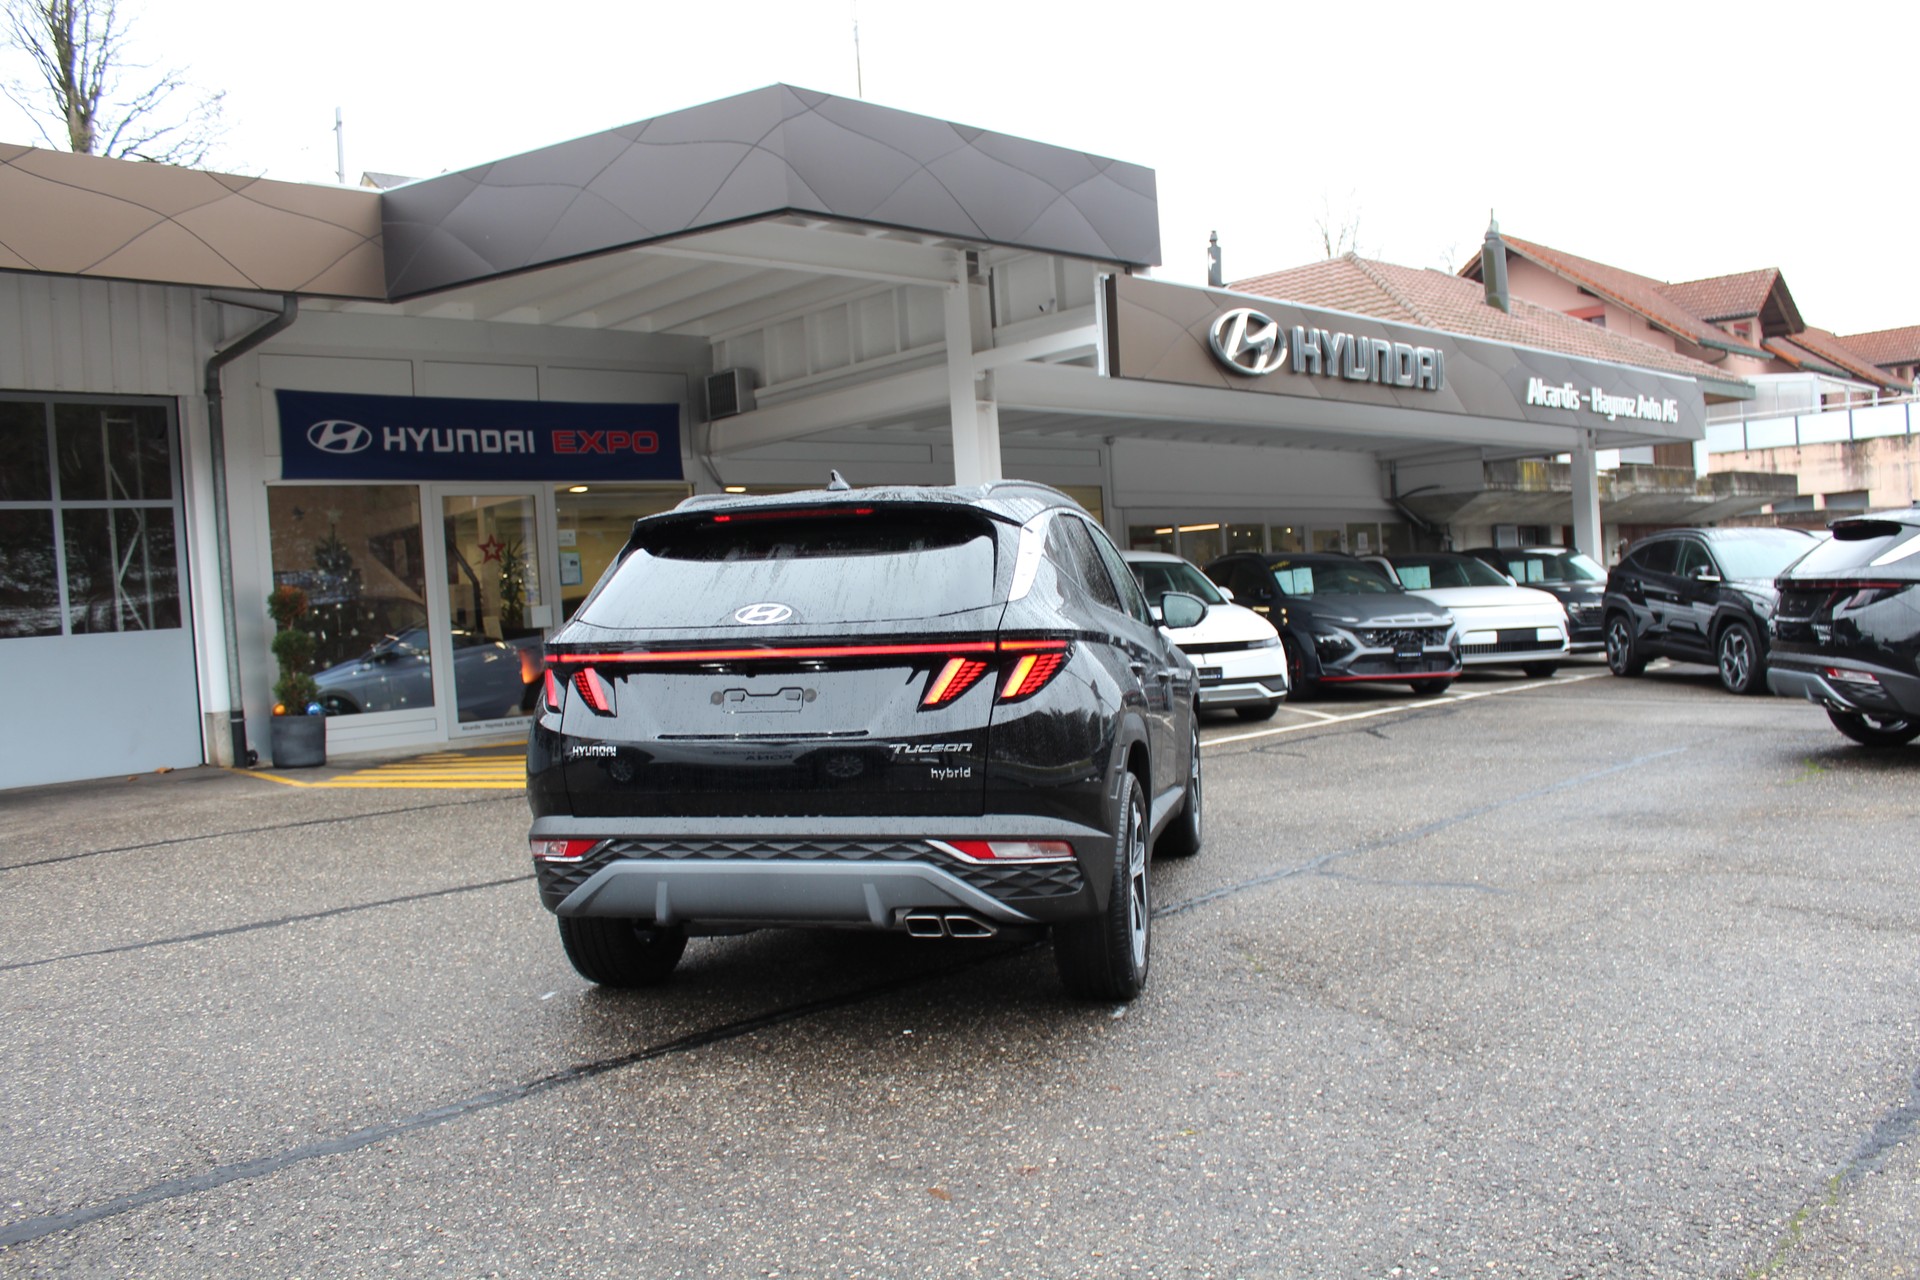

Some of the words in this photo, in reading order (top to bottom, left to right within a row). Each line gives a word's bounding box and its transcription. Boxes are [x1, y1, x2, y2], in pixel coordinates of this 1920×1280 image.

[1292, 325, 1445, 391] HYUNDAI
[1527, 377, 1580, 410] Alcardis
[1591, 387, 1636, 421] Haymoz
[1637, 394, 1661, 421] Auto
[1662, 398, 1678, 423] AG
[383, 427, 535, 453] HYUNDAI
[552, 430, 659, 454] EXPO
[572, 745, 617, 757] HYUNDAI
[930, 767, 971, 780] hybrid
